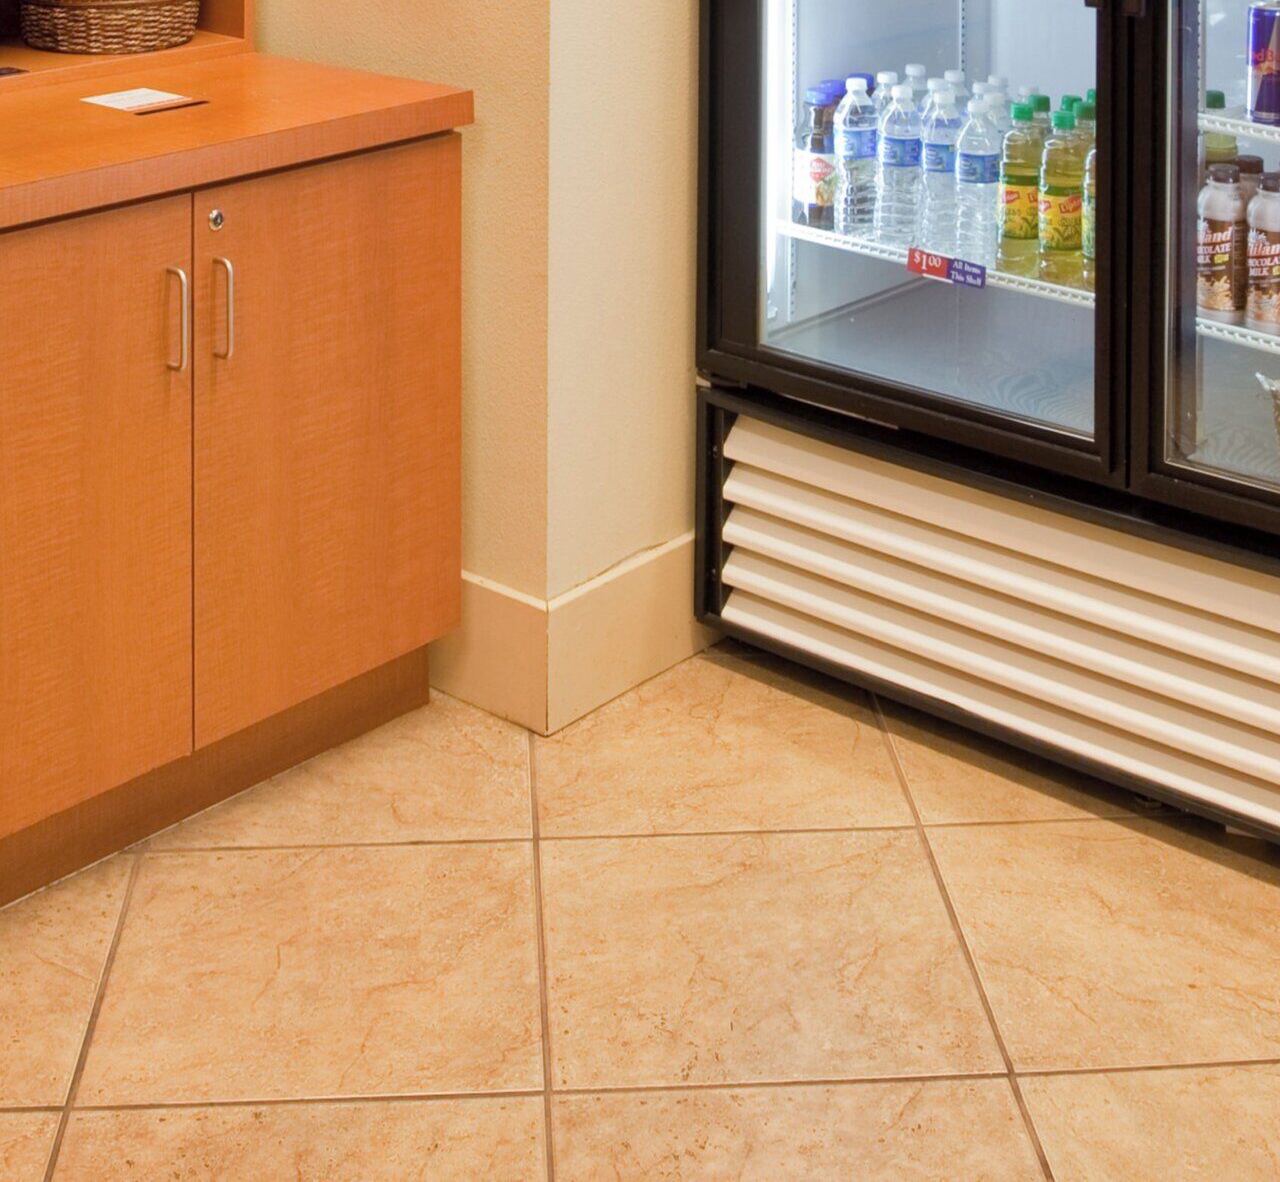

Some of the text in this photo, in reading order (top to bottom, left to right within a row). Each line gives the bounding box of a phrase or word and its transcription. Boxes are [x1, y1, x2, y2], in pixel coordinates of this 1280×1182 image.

[952, 260, 981, 275] All Items
[950, 272, 983, 286] This Shelf
